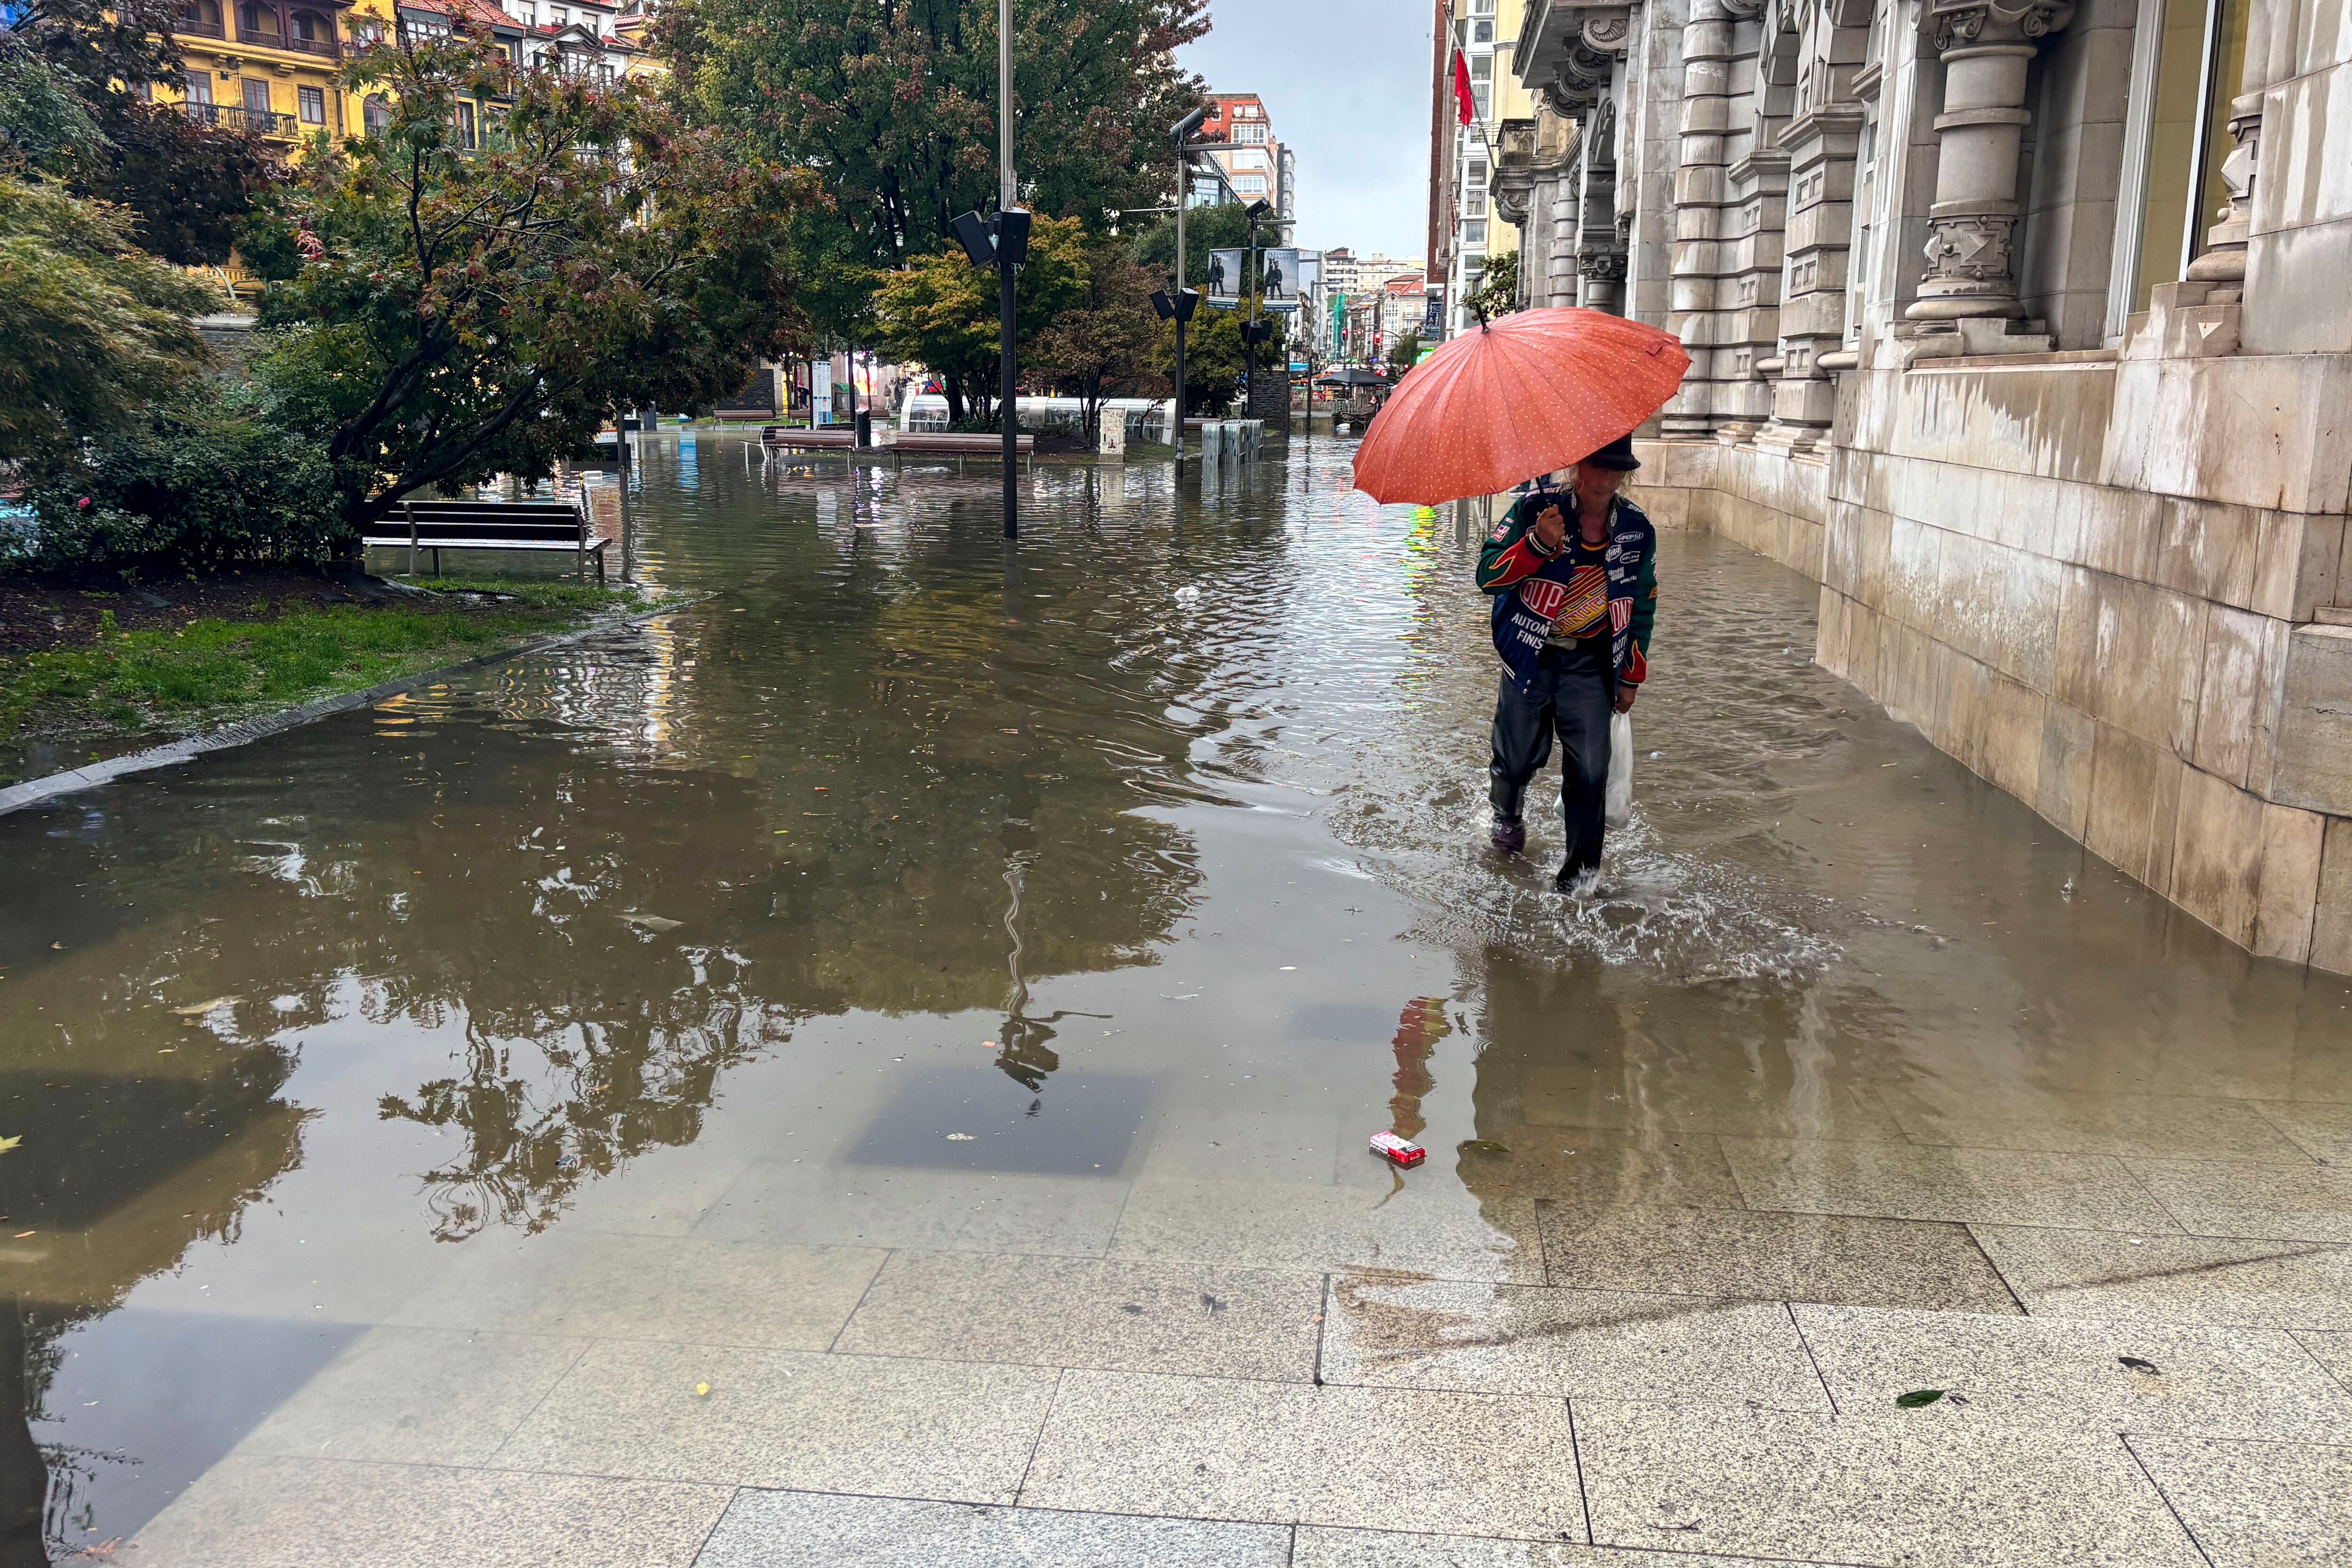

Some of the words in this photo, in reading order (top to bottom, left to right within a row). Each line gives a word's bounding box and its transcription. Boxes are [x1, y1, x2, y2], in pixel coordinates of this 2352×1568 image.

[1511, 612, 1550, 637] AUTOM
[1609, 599, 1633, 632] ONT
[1517, 630, 1545, 649] FINIS
